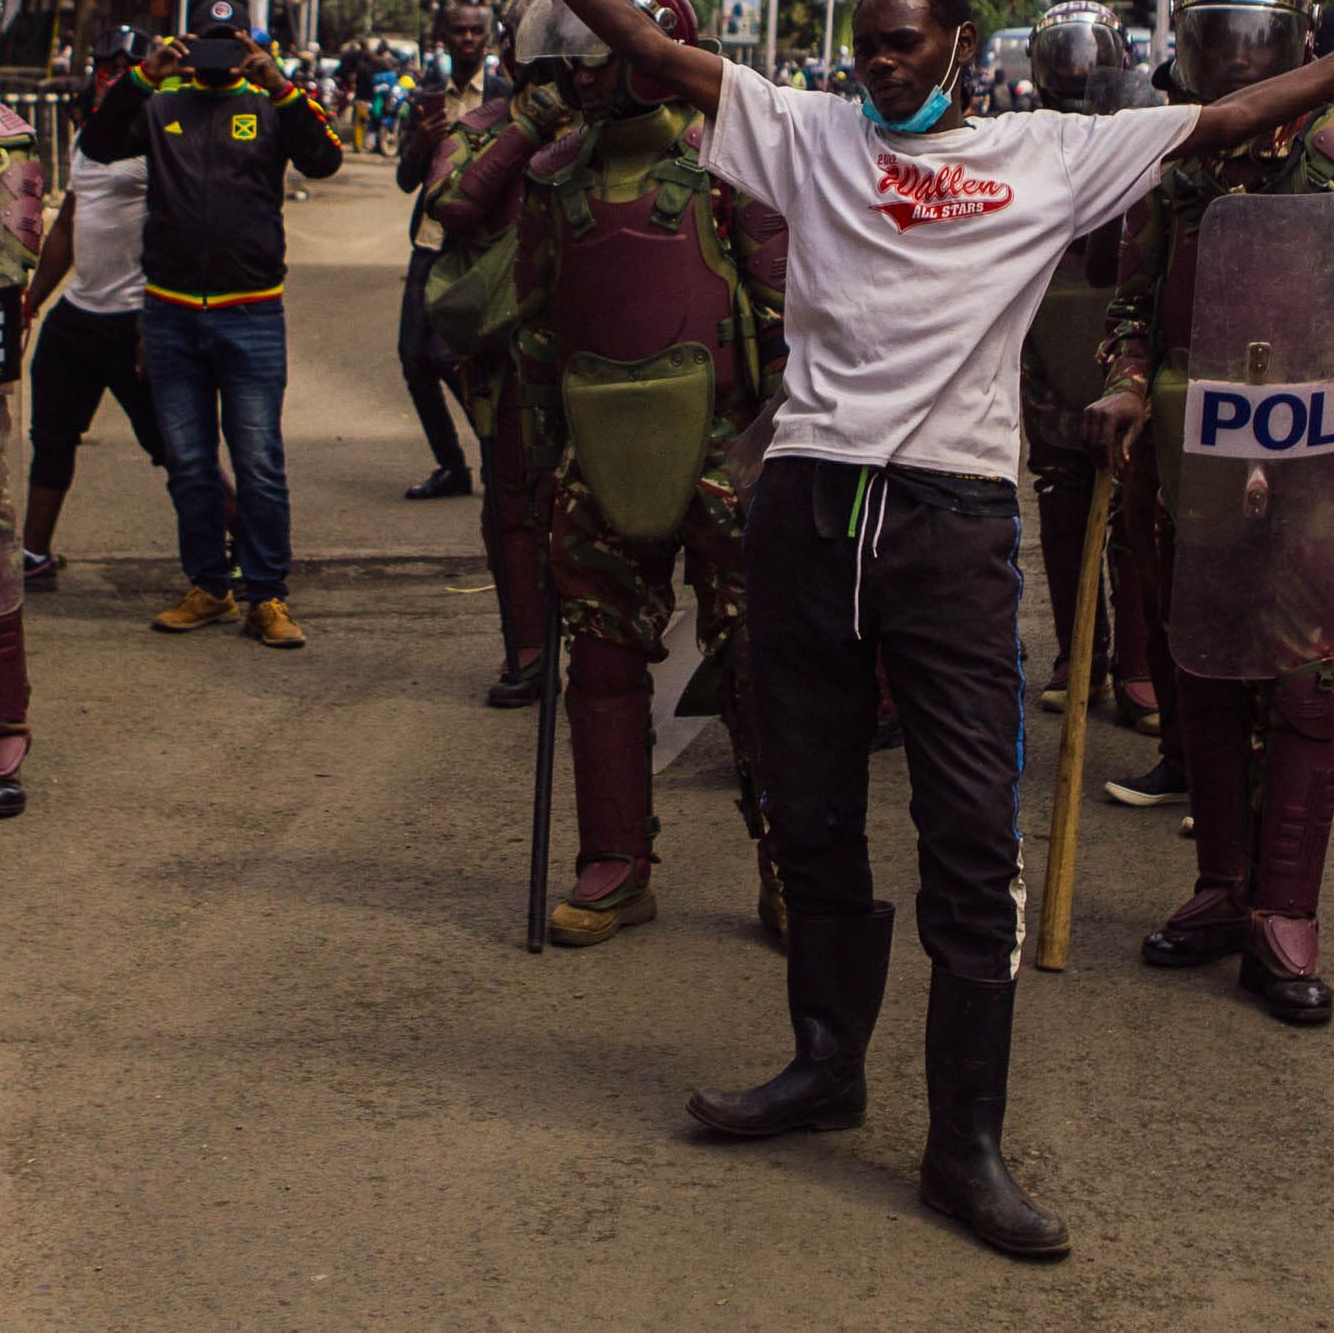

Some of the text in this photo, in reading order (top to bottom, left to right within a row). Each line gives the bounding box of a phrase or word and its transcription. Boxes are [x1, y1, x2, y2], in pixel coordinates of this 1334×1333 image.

[877, 164, 1005, 203] Wallen
[912, 202, 984, 219] ALL STARS
